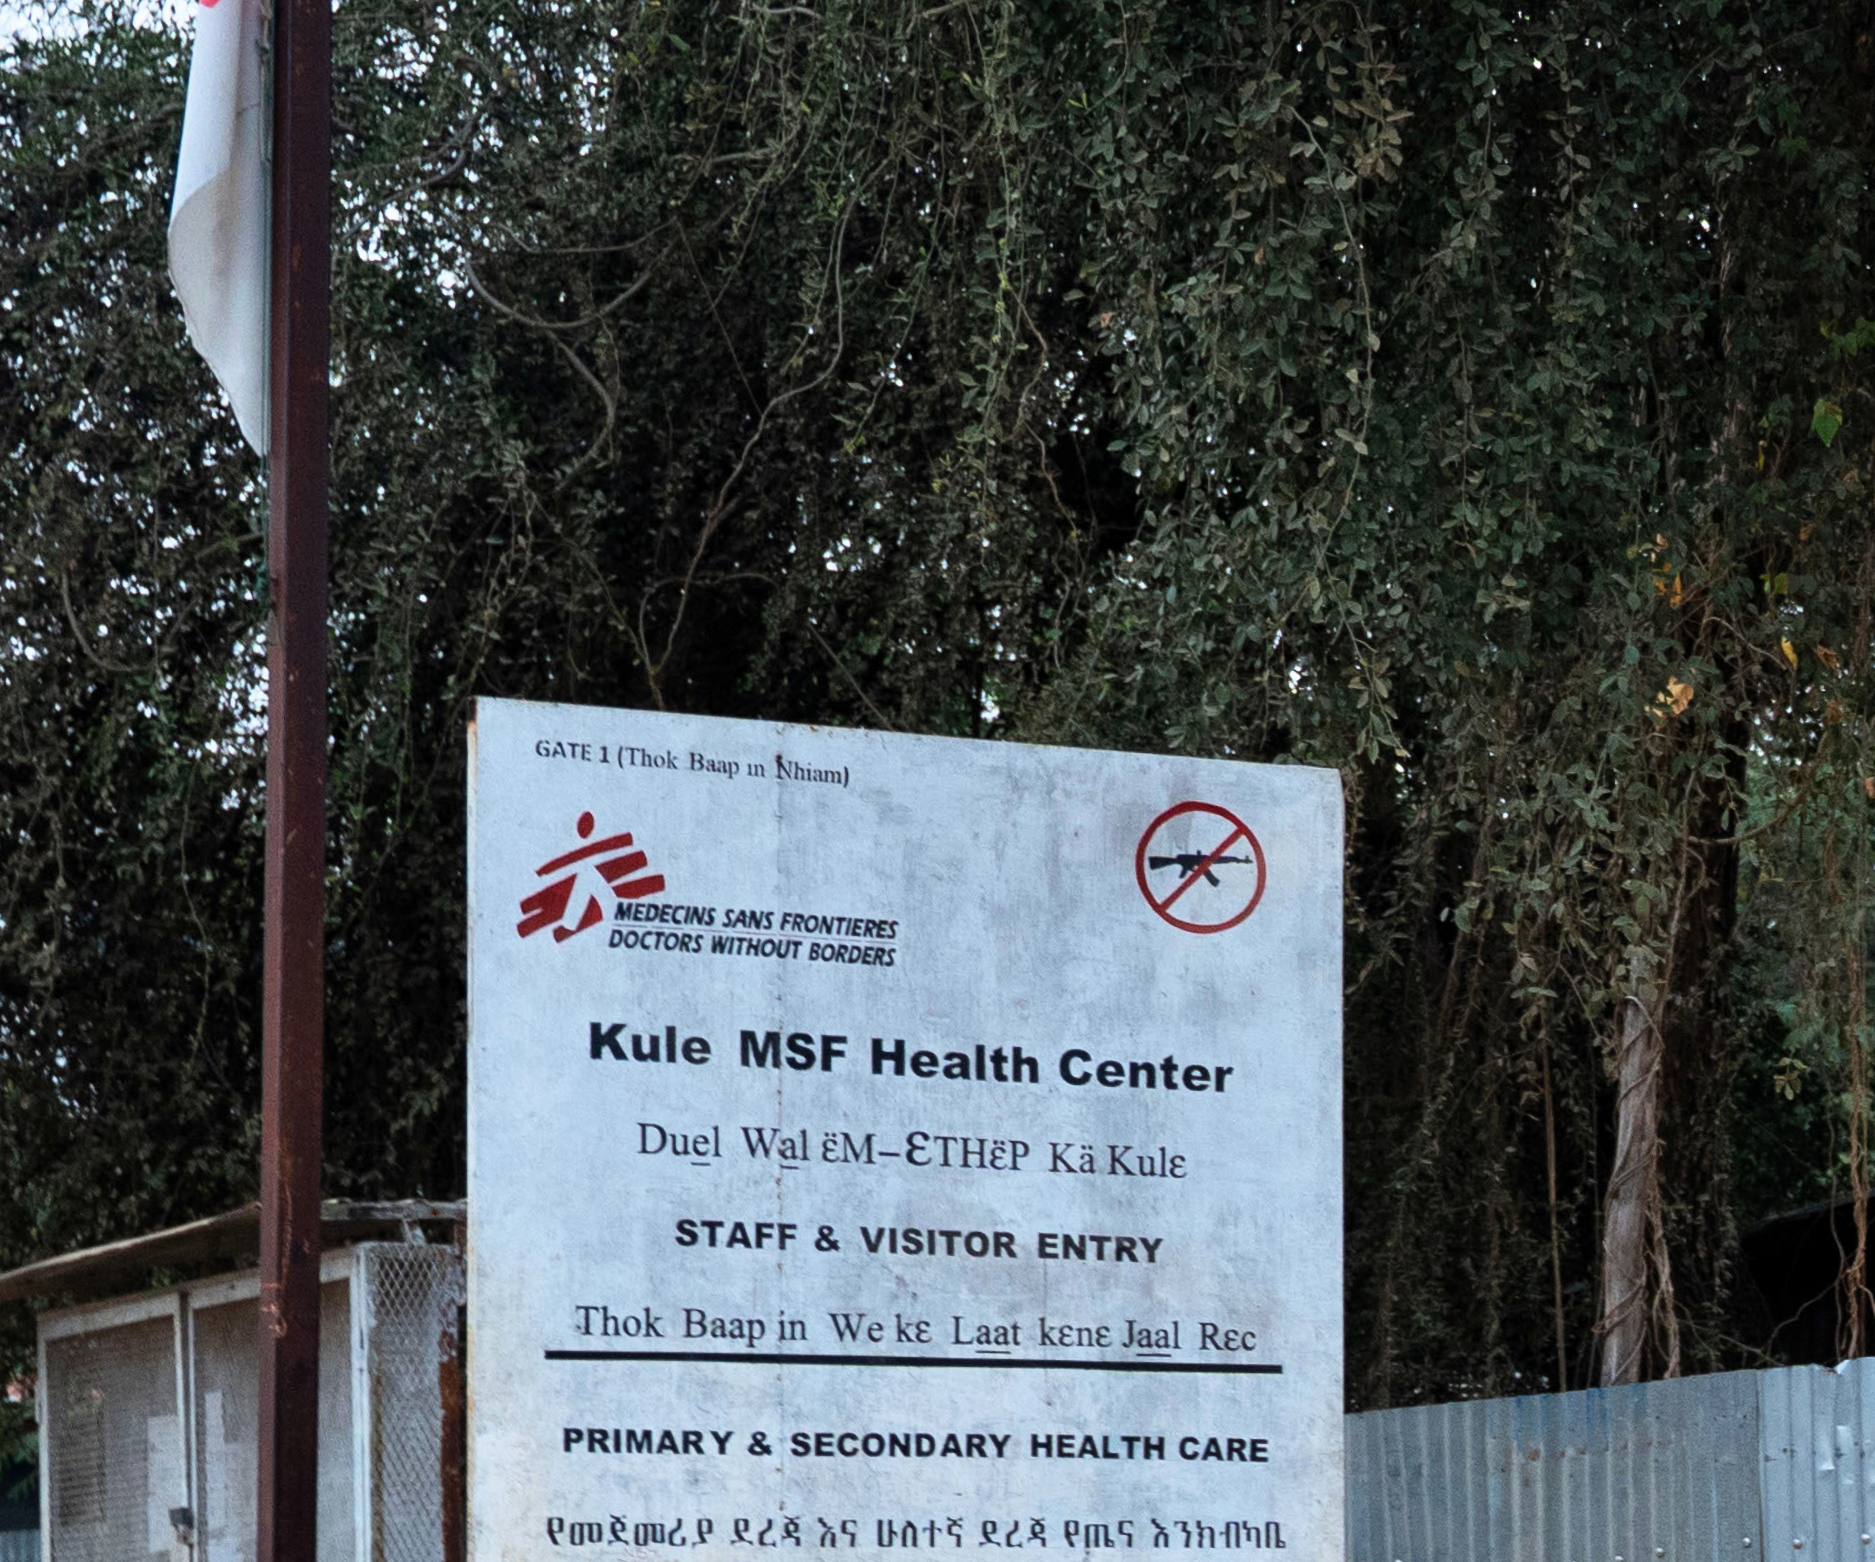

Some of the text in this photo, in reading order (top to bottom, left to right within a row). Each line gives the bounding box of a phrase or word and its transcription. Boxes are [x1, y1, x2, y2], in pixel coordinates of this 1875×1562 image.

[535, 740, 592, 763] GATE
[598, 745, 611, 765] 1
[617, 745, 679, 770] (Thok
[689, 751, 741, 780] Baap
[774, 757, 850, 788] Nhiam)
[613, 902, 899, 940] MEDECINS SANS FRONTIERES
[607, 929, 898, 968] DOCTORS WITHOUT BORDERS
[589, 1021, 1235, 1094] Kule MSF Health Center
[1048, 1141, 1097, 1175] Kä
[675, 1218, 1165, 1264] STAFF & VISITOR ENTRY
[575, 1304, 665, 1339] Thok
[681, 1307, 766, 1349] Baap
[777, 1309, 809, 1342] in
[828, 1311, 885, 1345] We
[562, 1427, 1270, 1464] PRIMARY & SECONDARY HEALTH CARE
[729, 1515, 803, 1549] ደረጃ
[978, 1516, 1047, 1549] ደረጃ
